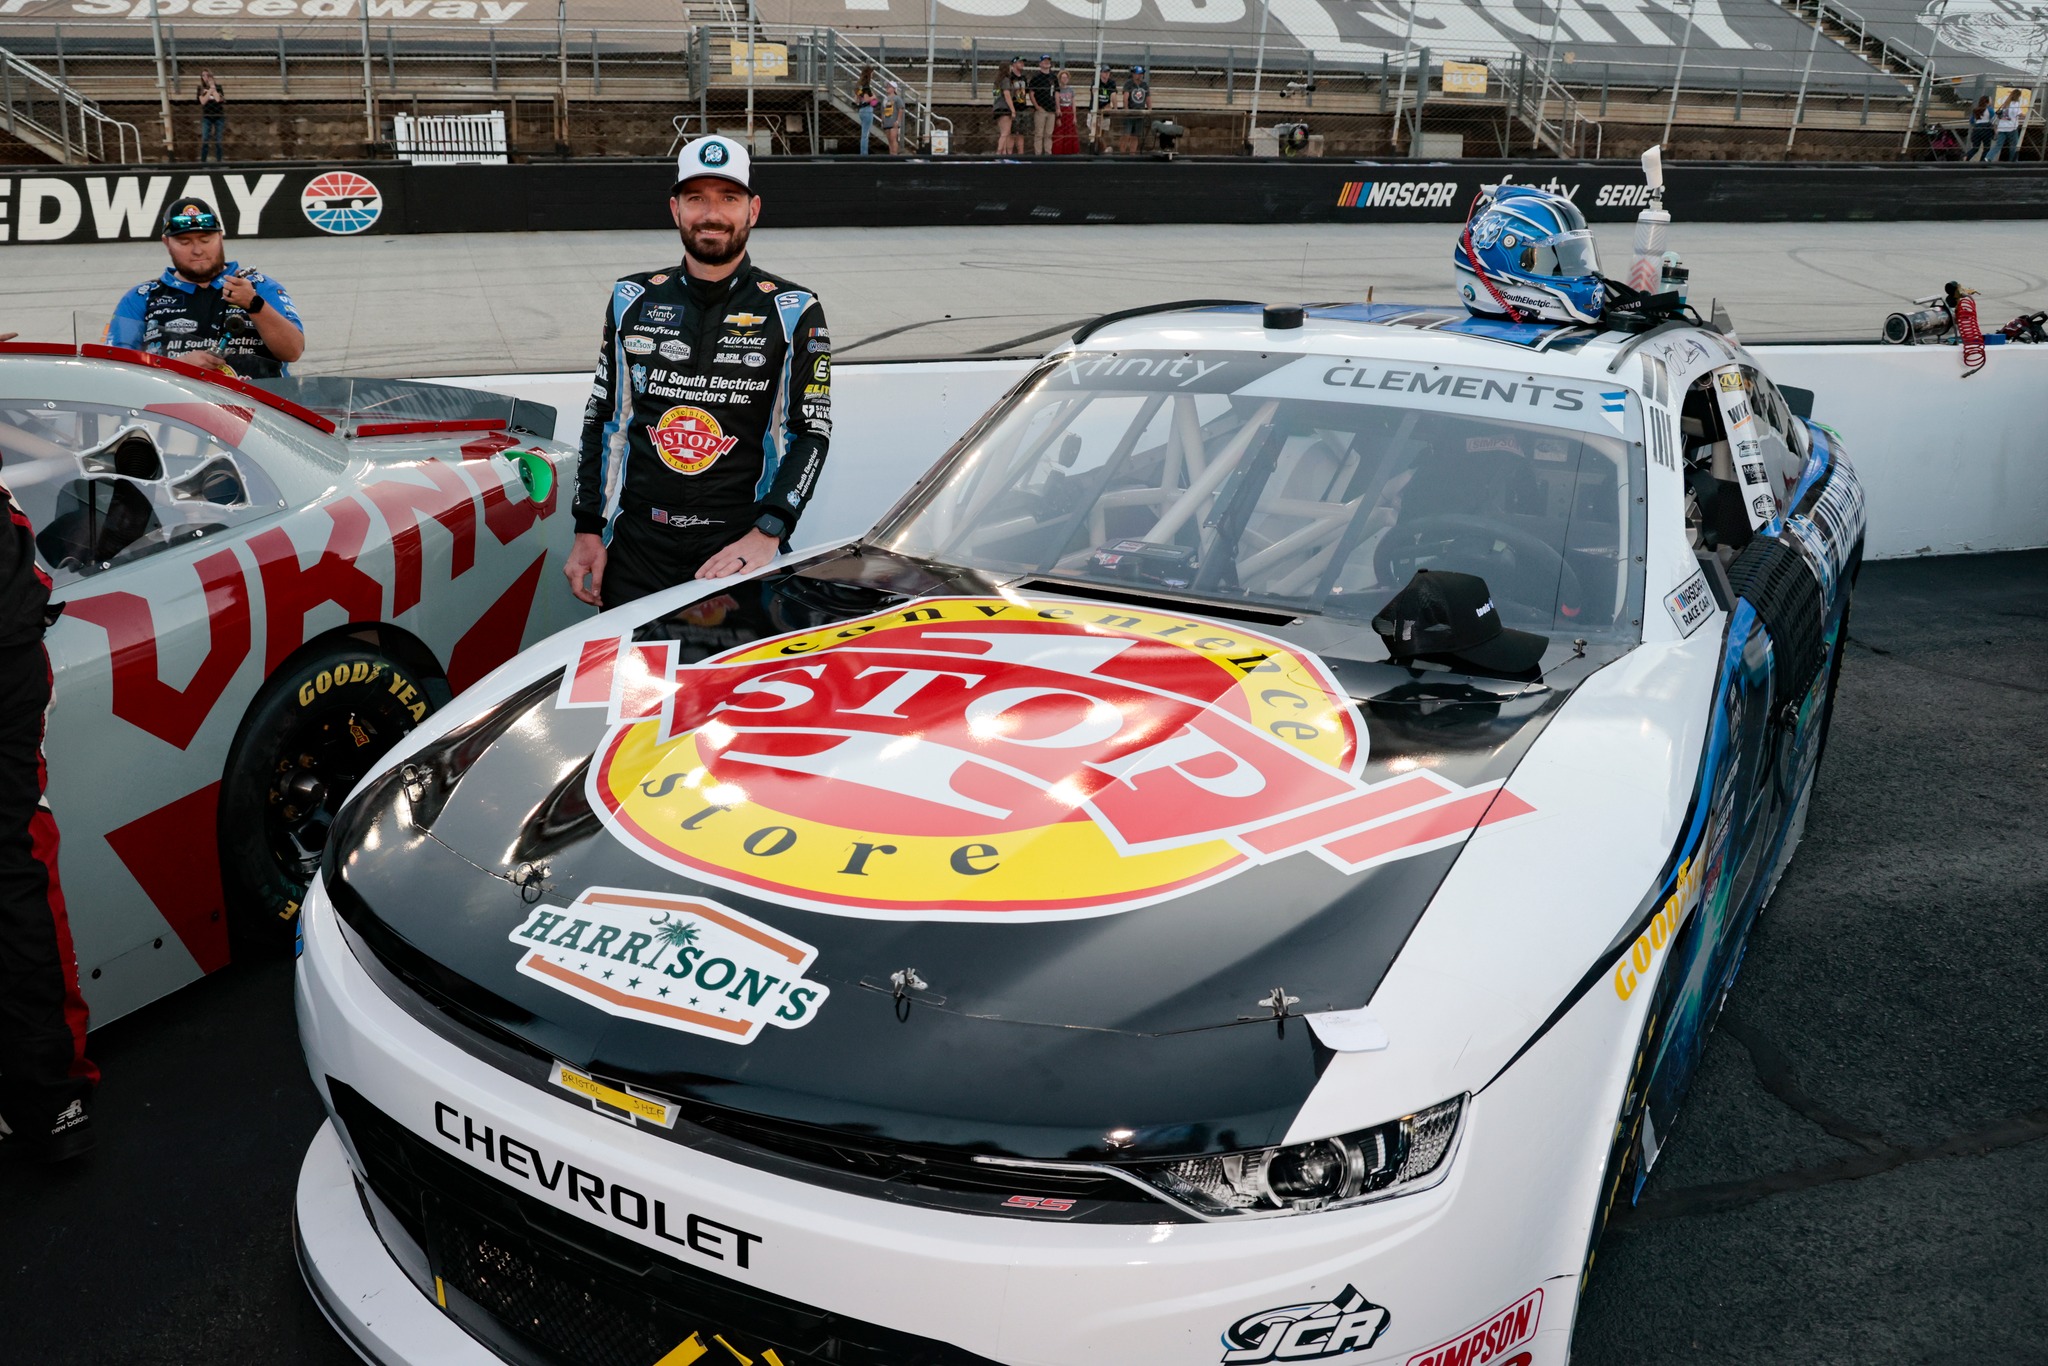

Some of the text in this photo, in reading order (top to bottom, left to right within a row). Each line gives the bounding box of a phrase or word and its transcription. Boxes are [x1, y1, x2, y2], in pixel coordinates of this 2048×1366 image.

[1365, 182, 1458, 207] NASCAR
[0, 174, 286, 241] DWAY
[647, 308, 676, 320] xfinity
[633, 324, 680, 336] GOODYEAR
[717, 336, 767, 346] ALLIANCE
[167, 340, 182, 350] All
[747, 354, 761, 362] FOX
[1052, 352, 1229, 387] xfinity
[649, 369, 770, 391] All South Electrical
[1322, 366, 1584, 411] CLEMENTS
[648, 382, 752, 404] Constructors Inc.
[662, 410, 718, 434] convenience
[1727, 400, 1750, 424] WIX
[663, 431, 717, 450] STOP
[1680, 578, 1706, 606] NASCAR
[1682, 596, 1711, 627] RACE CAR
[781, 602, 1320, 741] convenience
[707, 663, 1267, 798] STOP
[639, 772, 1001, 877] store
[518, 910, 818, 1023] HARRISON'S
[561, 1070, 665, 1117] BRISTOL SHIP
[51, 1123, 66, 1135] new
[434, 1100, 763, 1270] CHEVROLET
[1000, 1195, 1078, 1212] SS
[1221, 1306, 1387, 1364] JCR
